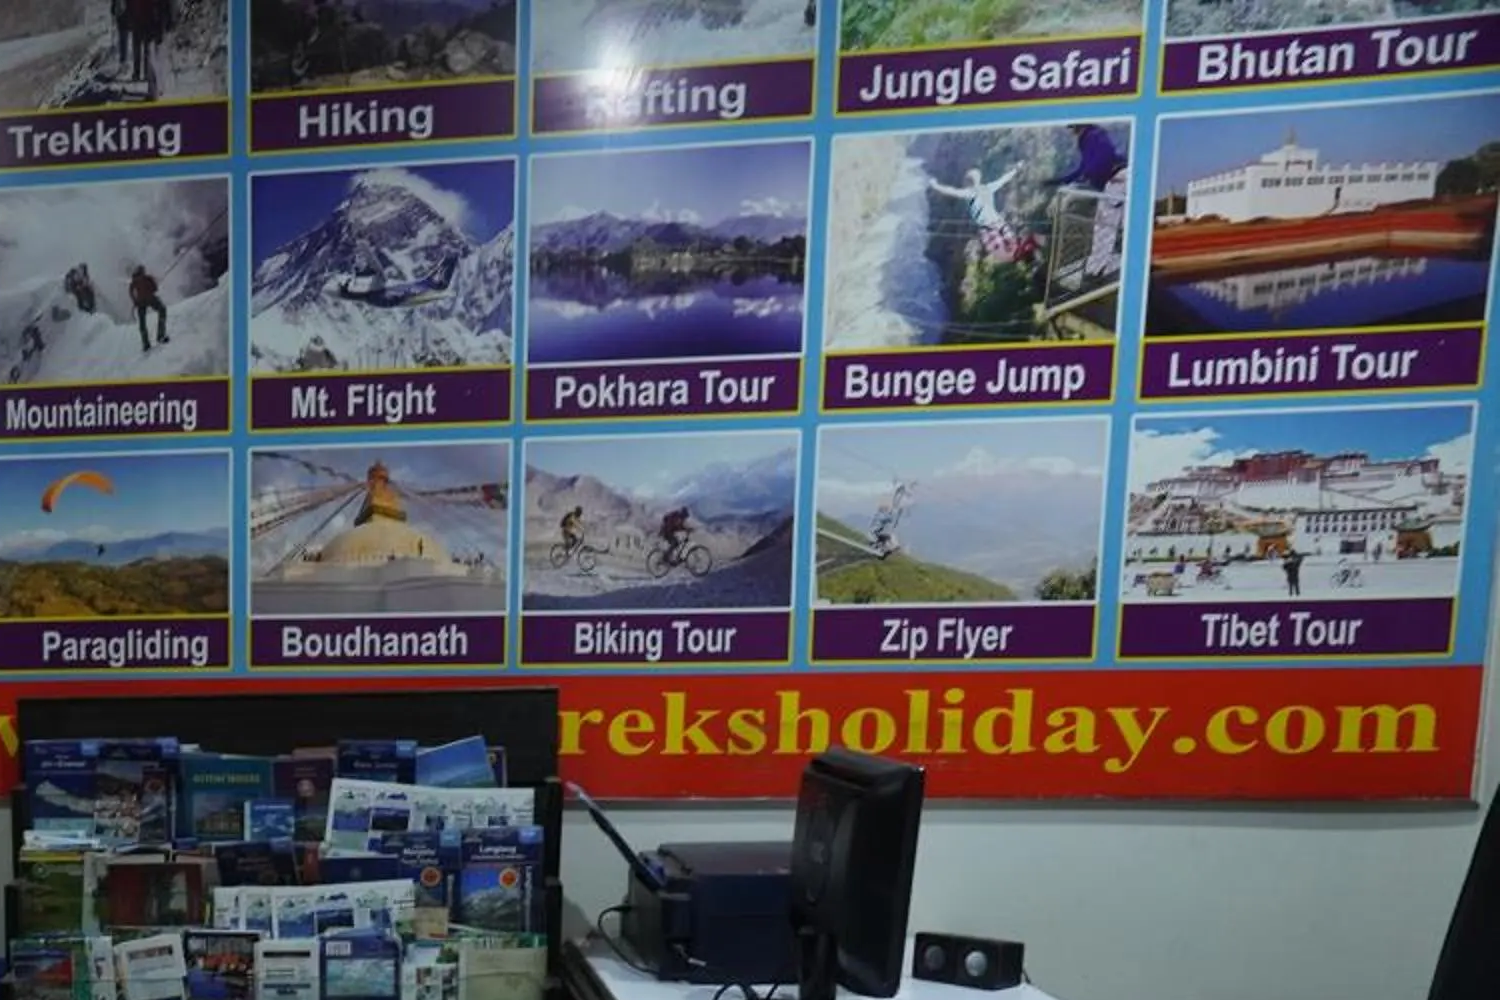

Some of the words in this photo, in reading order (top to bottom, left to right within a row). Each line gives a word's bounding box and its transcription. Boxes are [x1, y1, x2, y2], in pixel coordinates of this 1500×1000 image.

[1197, 36, 1357, 83] Bhutan
[1370, 27, 1477, 68] Tour
[859, 58, 997, 105] Jungle
[1009, 47, 1131, 91] Safari
[7, 118, 183, 159] Trekking
[299, 100, 435, 140] Hiking
[845, 364, 976, 404] Bungee
[985, 358, 1085, 400] Jump
[1168, 345, 1320, 388] Lumbini
[1331, 344, 1419, 381] Tour
[291, 385, 336, 419] Mt.
[347, 382, 437, 423] Flight
[555, 374, 689, 409] Pokhara
[699, 369, 776, 404] Tour
[5, 393, 198, 432] Mountaineering
[41, 629, 210, 669] Paragliding
[282, 623, 468, 657] Boudhanath
[575, 621, 663, 662] Biking
[671, 620, 737, 654] Tour
[880, 621, 928, 660] Zip
[937, 617, 1013, 660] Flyer
[1201, 613, 1281, 647] Tibet
[1289, 611, 1363, 646] Tour
[557, 687, 1439, 773] reksholiday.com
